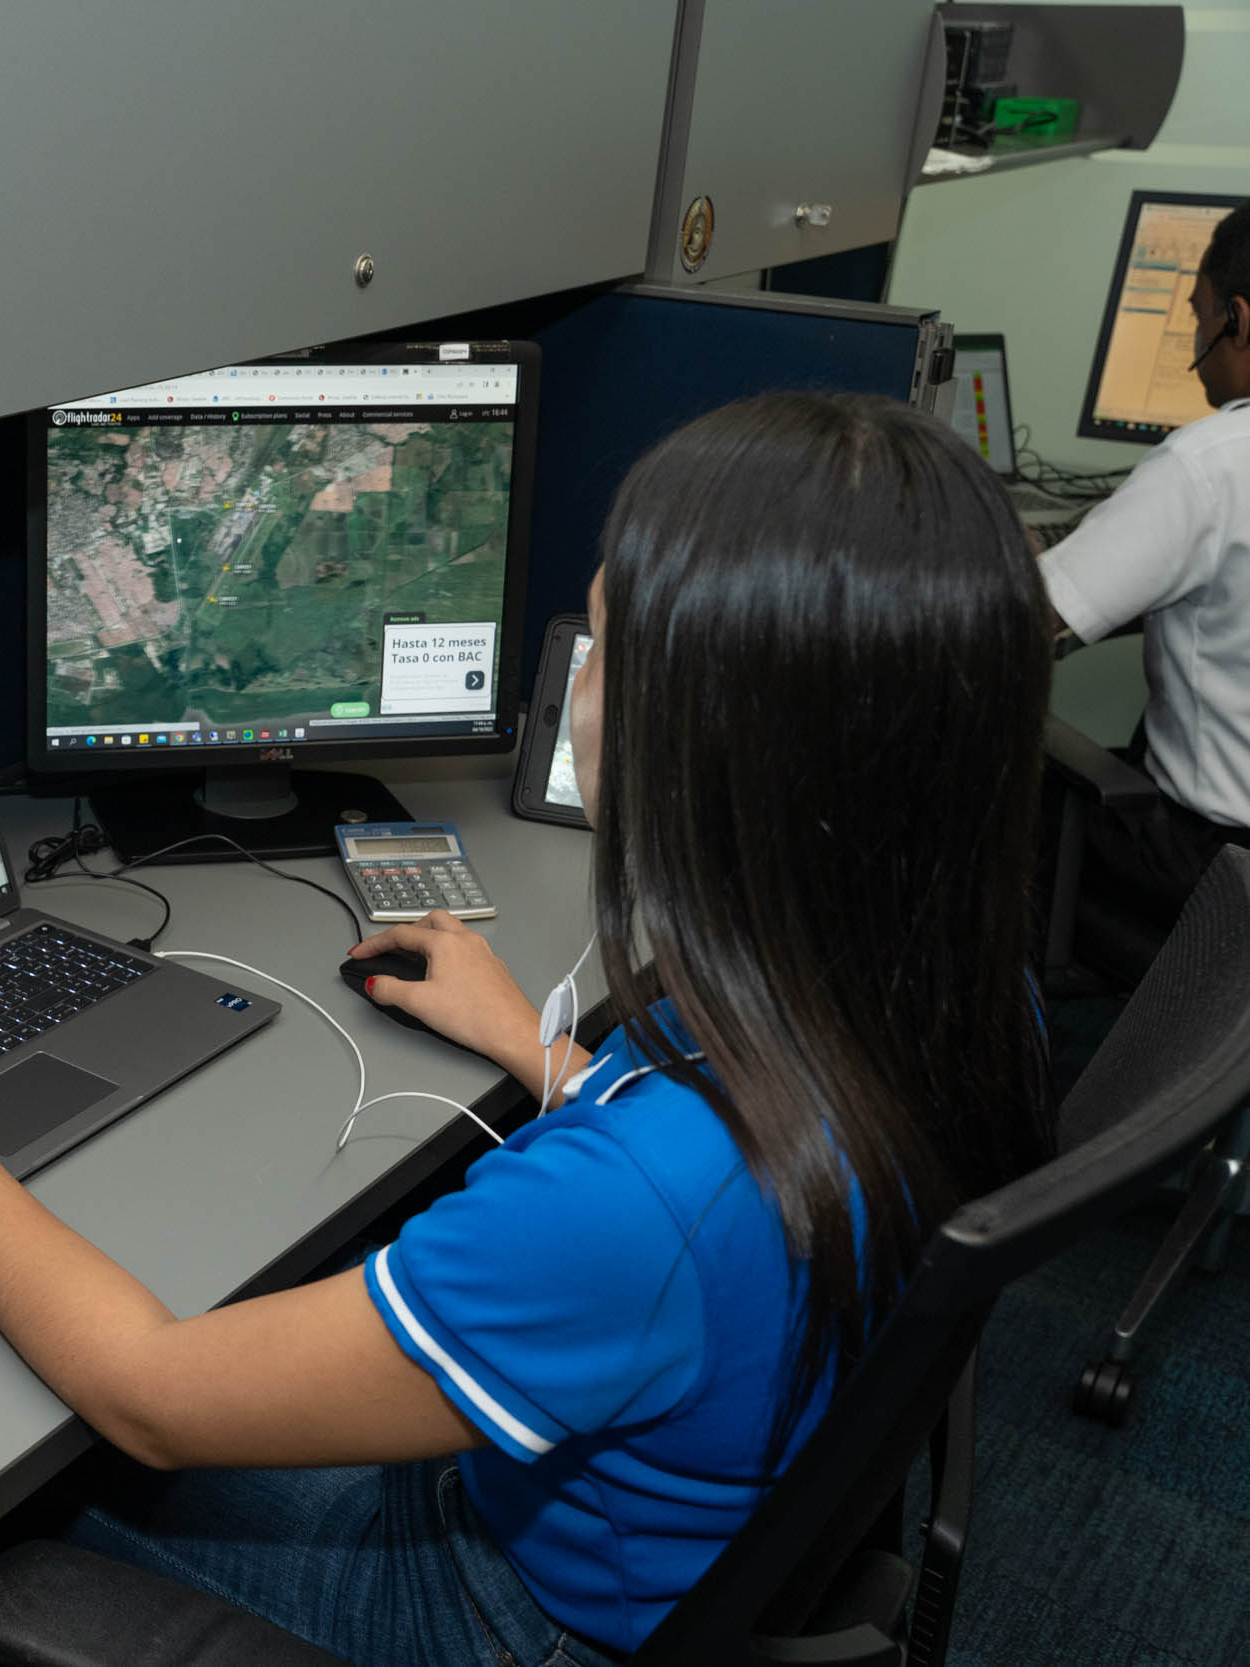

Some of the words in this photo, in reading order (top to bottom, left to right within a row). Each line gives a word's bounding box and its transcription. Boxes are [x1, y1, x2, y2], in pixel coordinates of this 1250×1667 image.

[67, 410, 123, 426] flightradar24
[392, 638, 428, 649] Hasta
[432, 638, 445, 648] 12
[448, 638, 487, 648] meses
[391, 653, 419, 664] Tasa
[422, 652, 430, 663] 0
[432, 653, 454, 663] con
[458, 651, 482, 662] BAC
